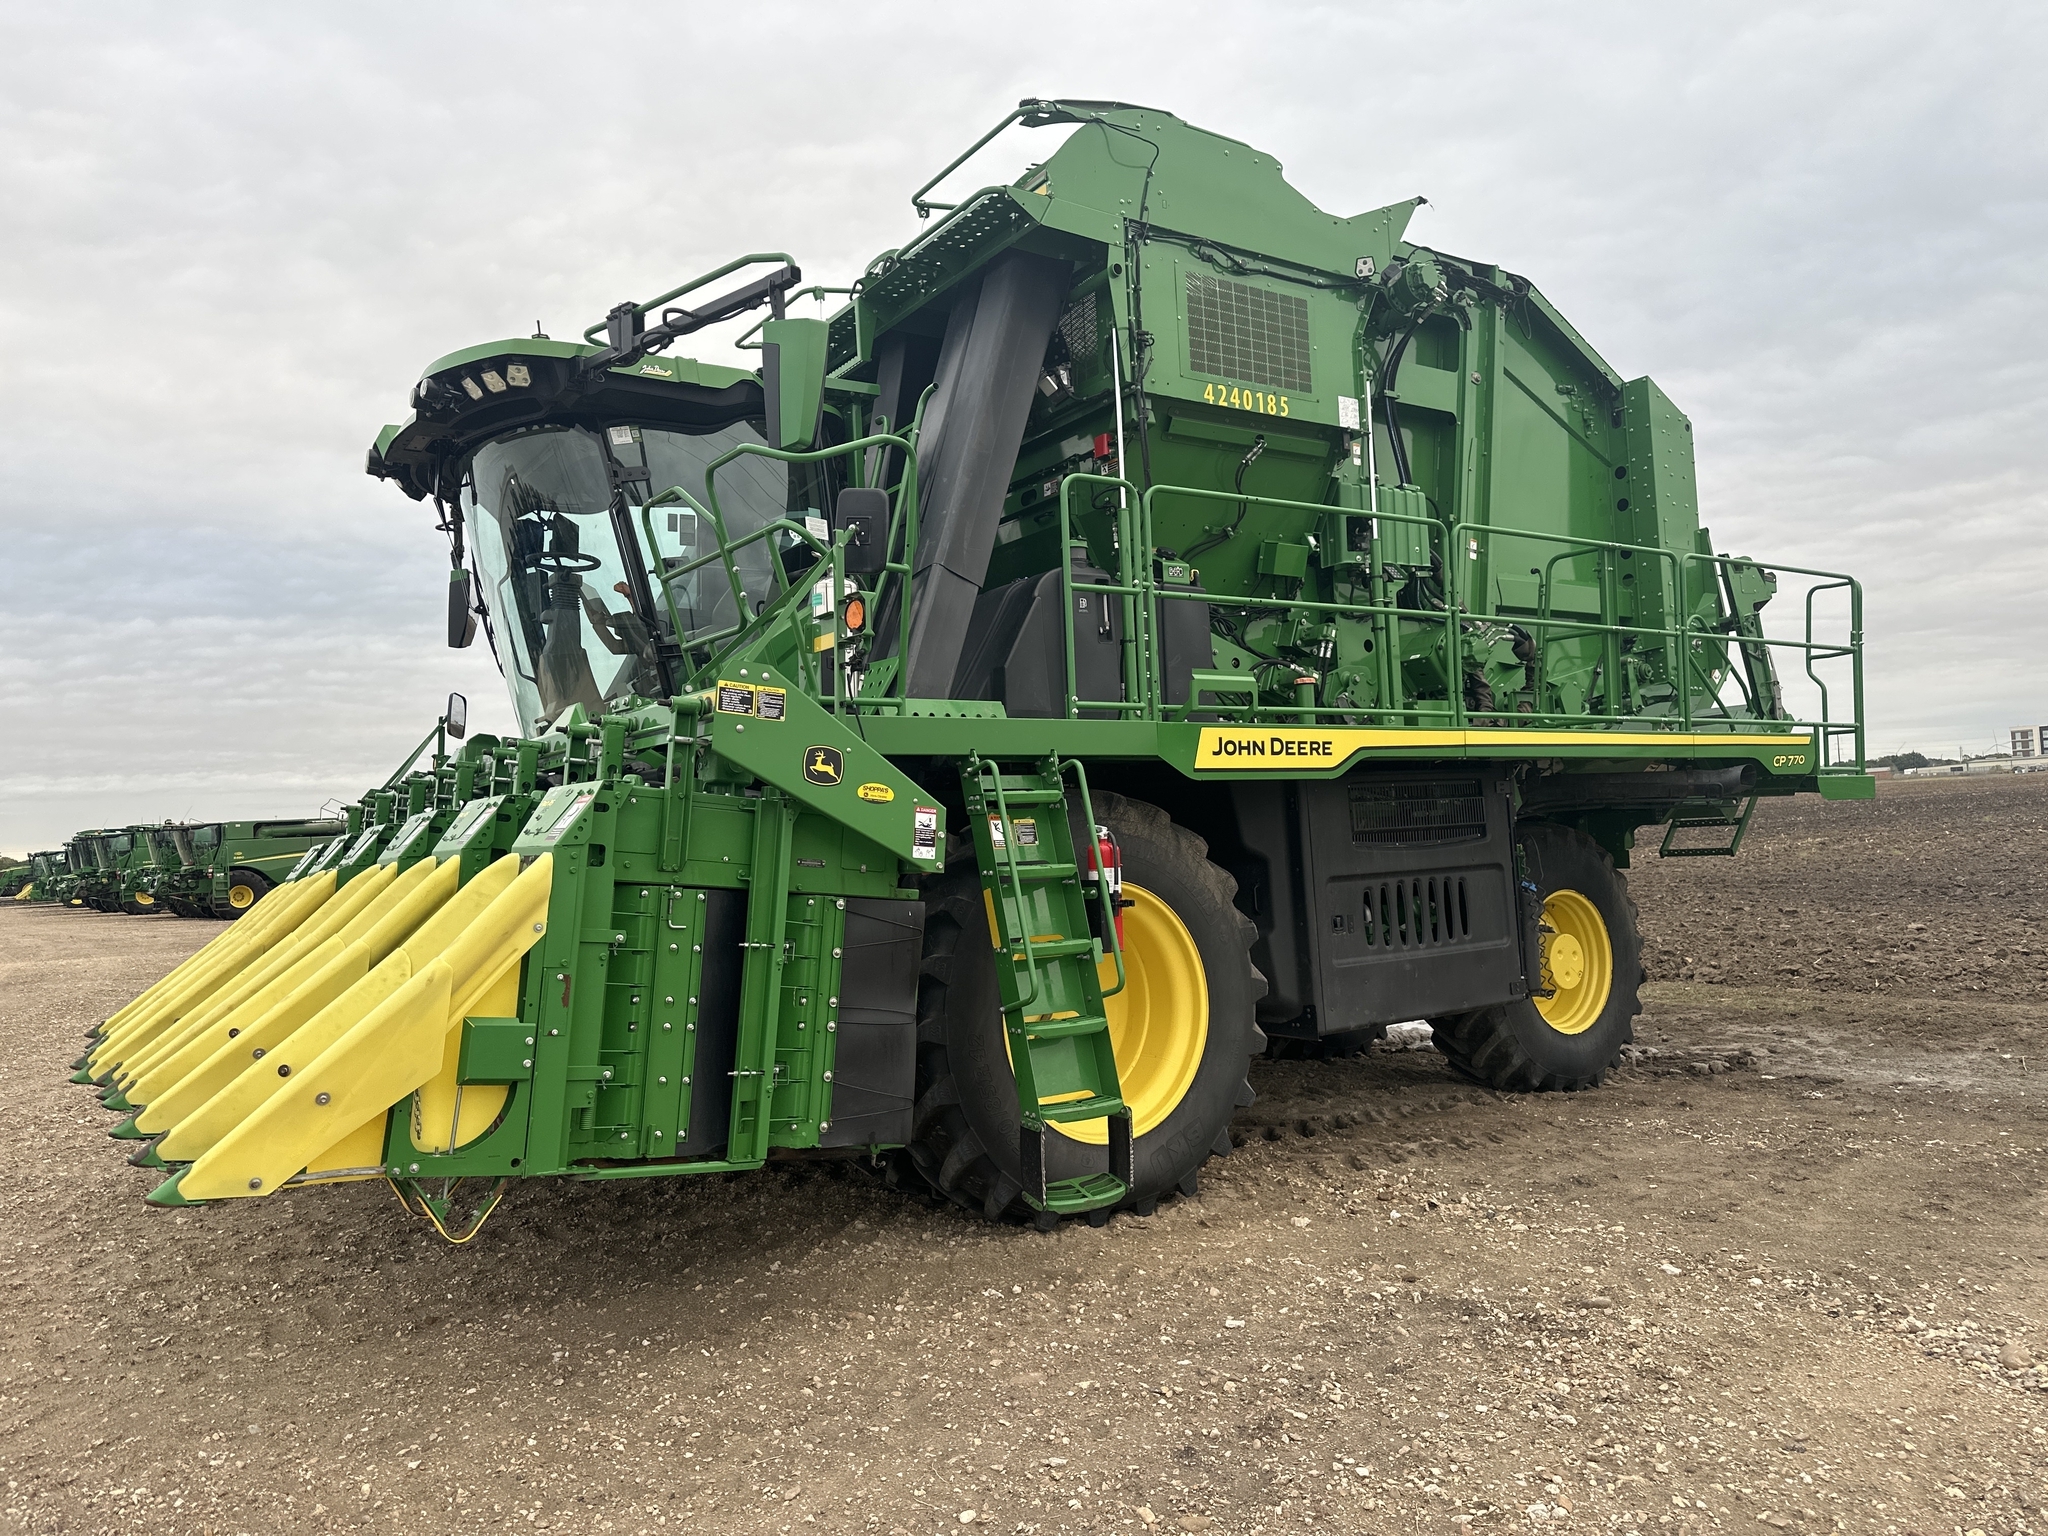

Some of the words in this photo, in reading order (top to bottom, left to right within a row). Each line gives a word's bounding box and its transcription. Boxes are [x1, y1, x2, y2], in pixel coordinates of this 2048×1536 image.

[1203, 383, 1290, 417] 4240185
[729, 682, 750, 690] CAUTION
[1212, 737, 1265, 756] JOHN
[1270, 737, 1333, 756] DEERE
[1773, 755, 1787, 767] CP
[1787, 755, 1805, 767] 770
